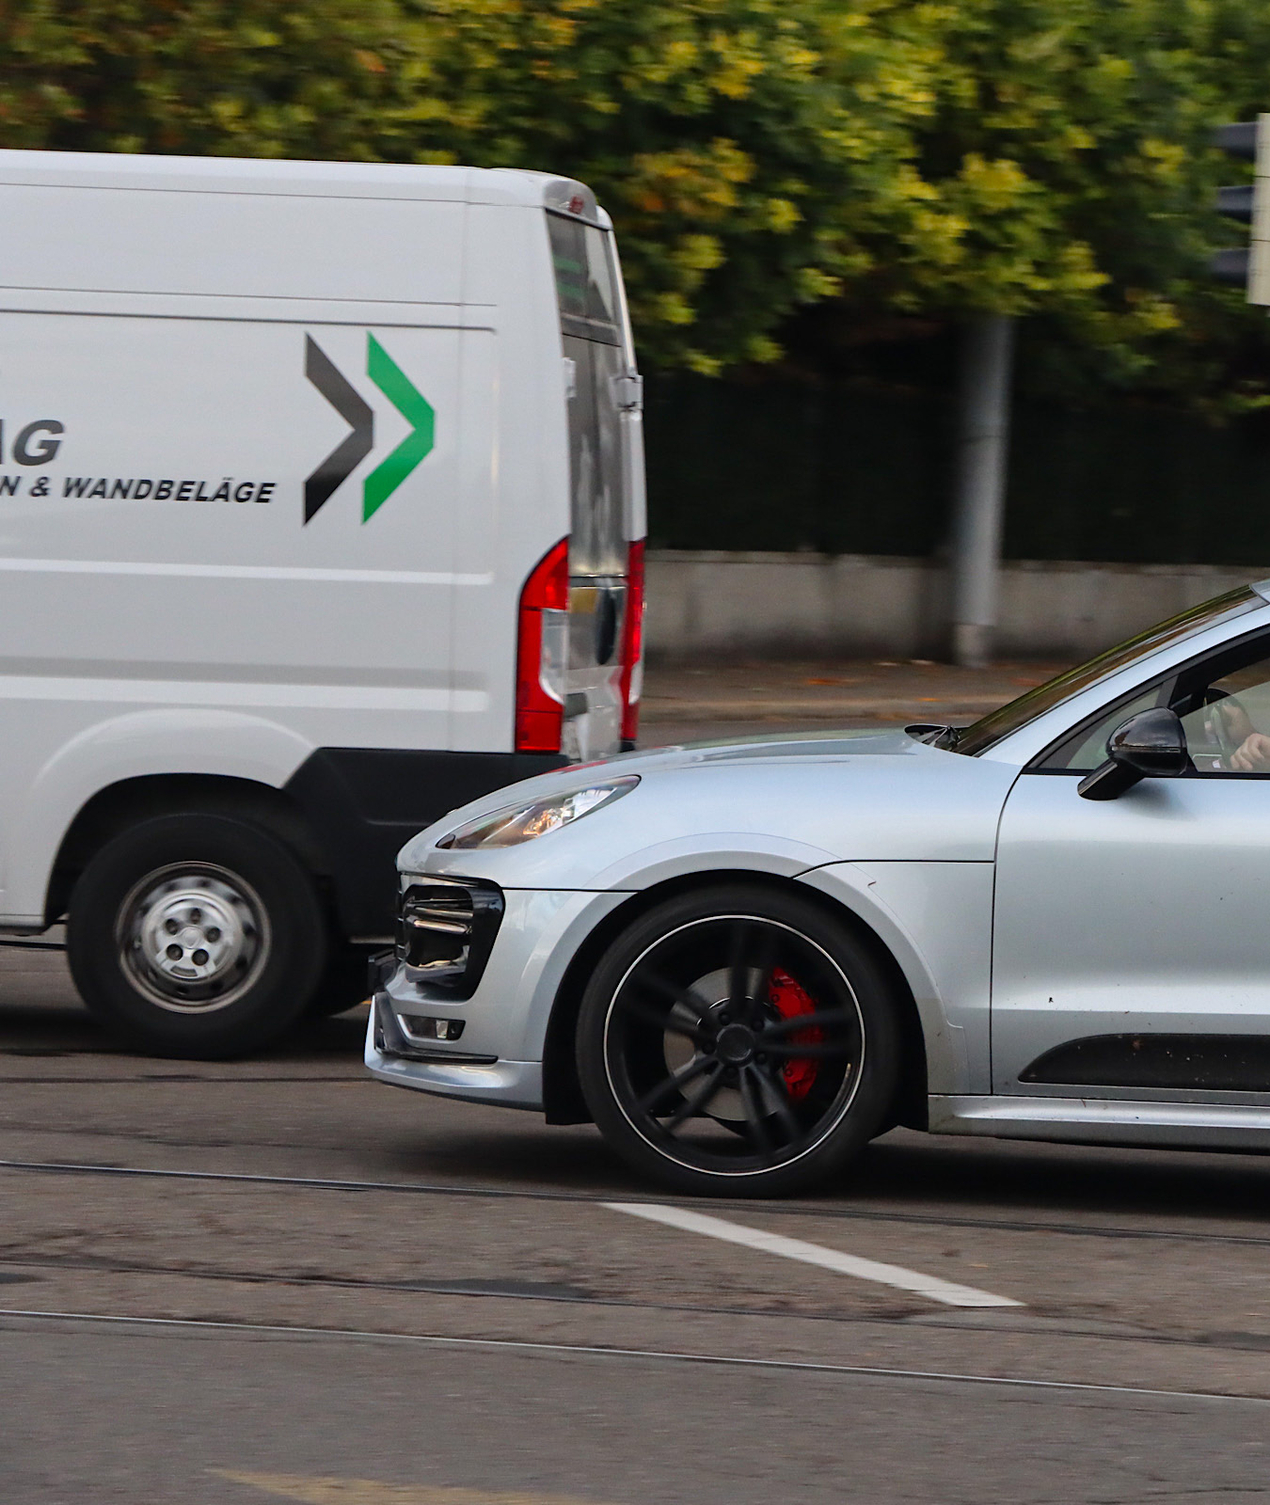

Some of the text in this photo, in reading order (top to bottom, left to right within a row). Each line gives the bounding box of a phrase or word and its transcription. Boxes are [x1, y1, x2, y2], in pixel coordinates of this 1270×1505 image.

[0, 419, 65, 466] G
[29, 476, 50, 497] &
[62, 477, 277, 503] WANDBELÄGE
